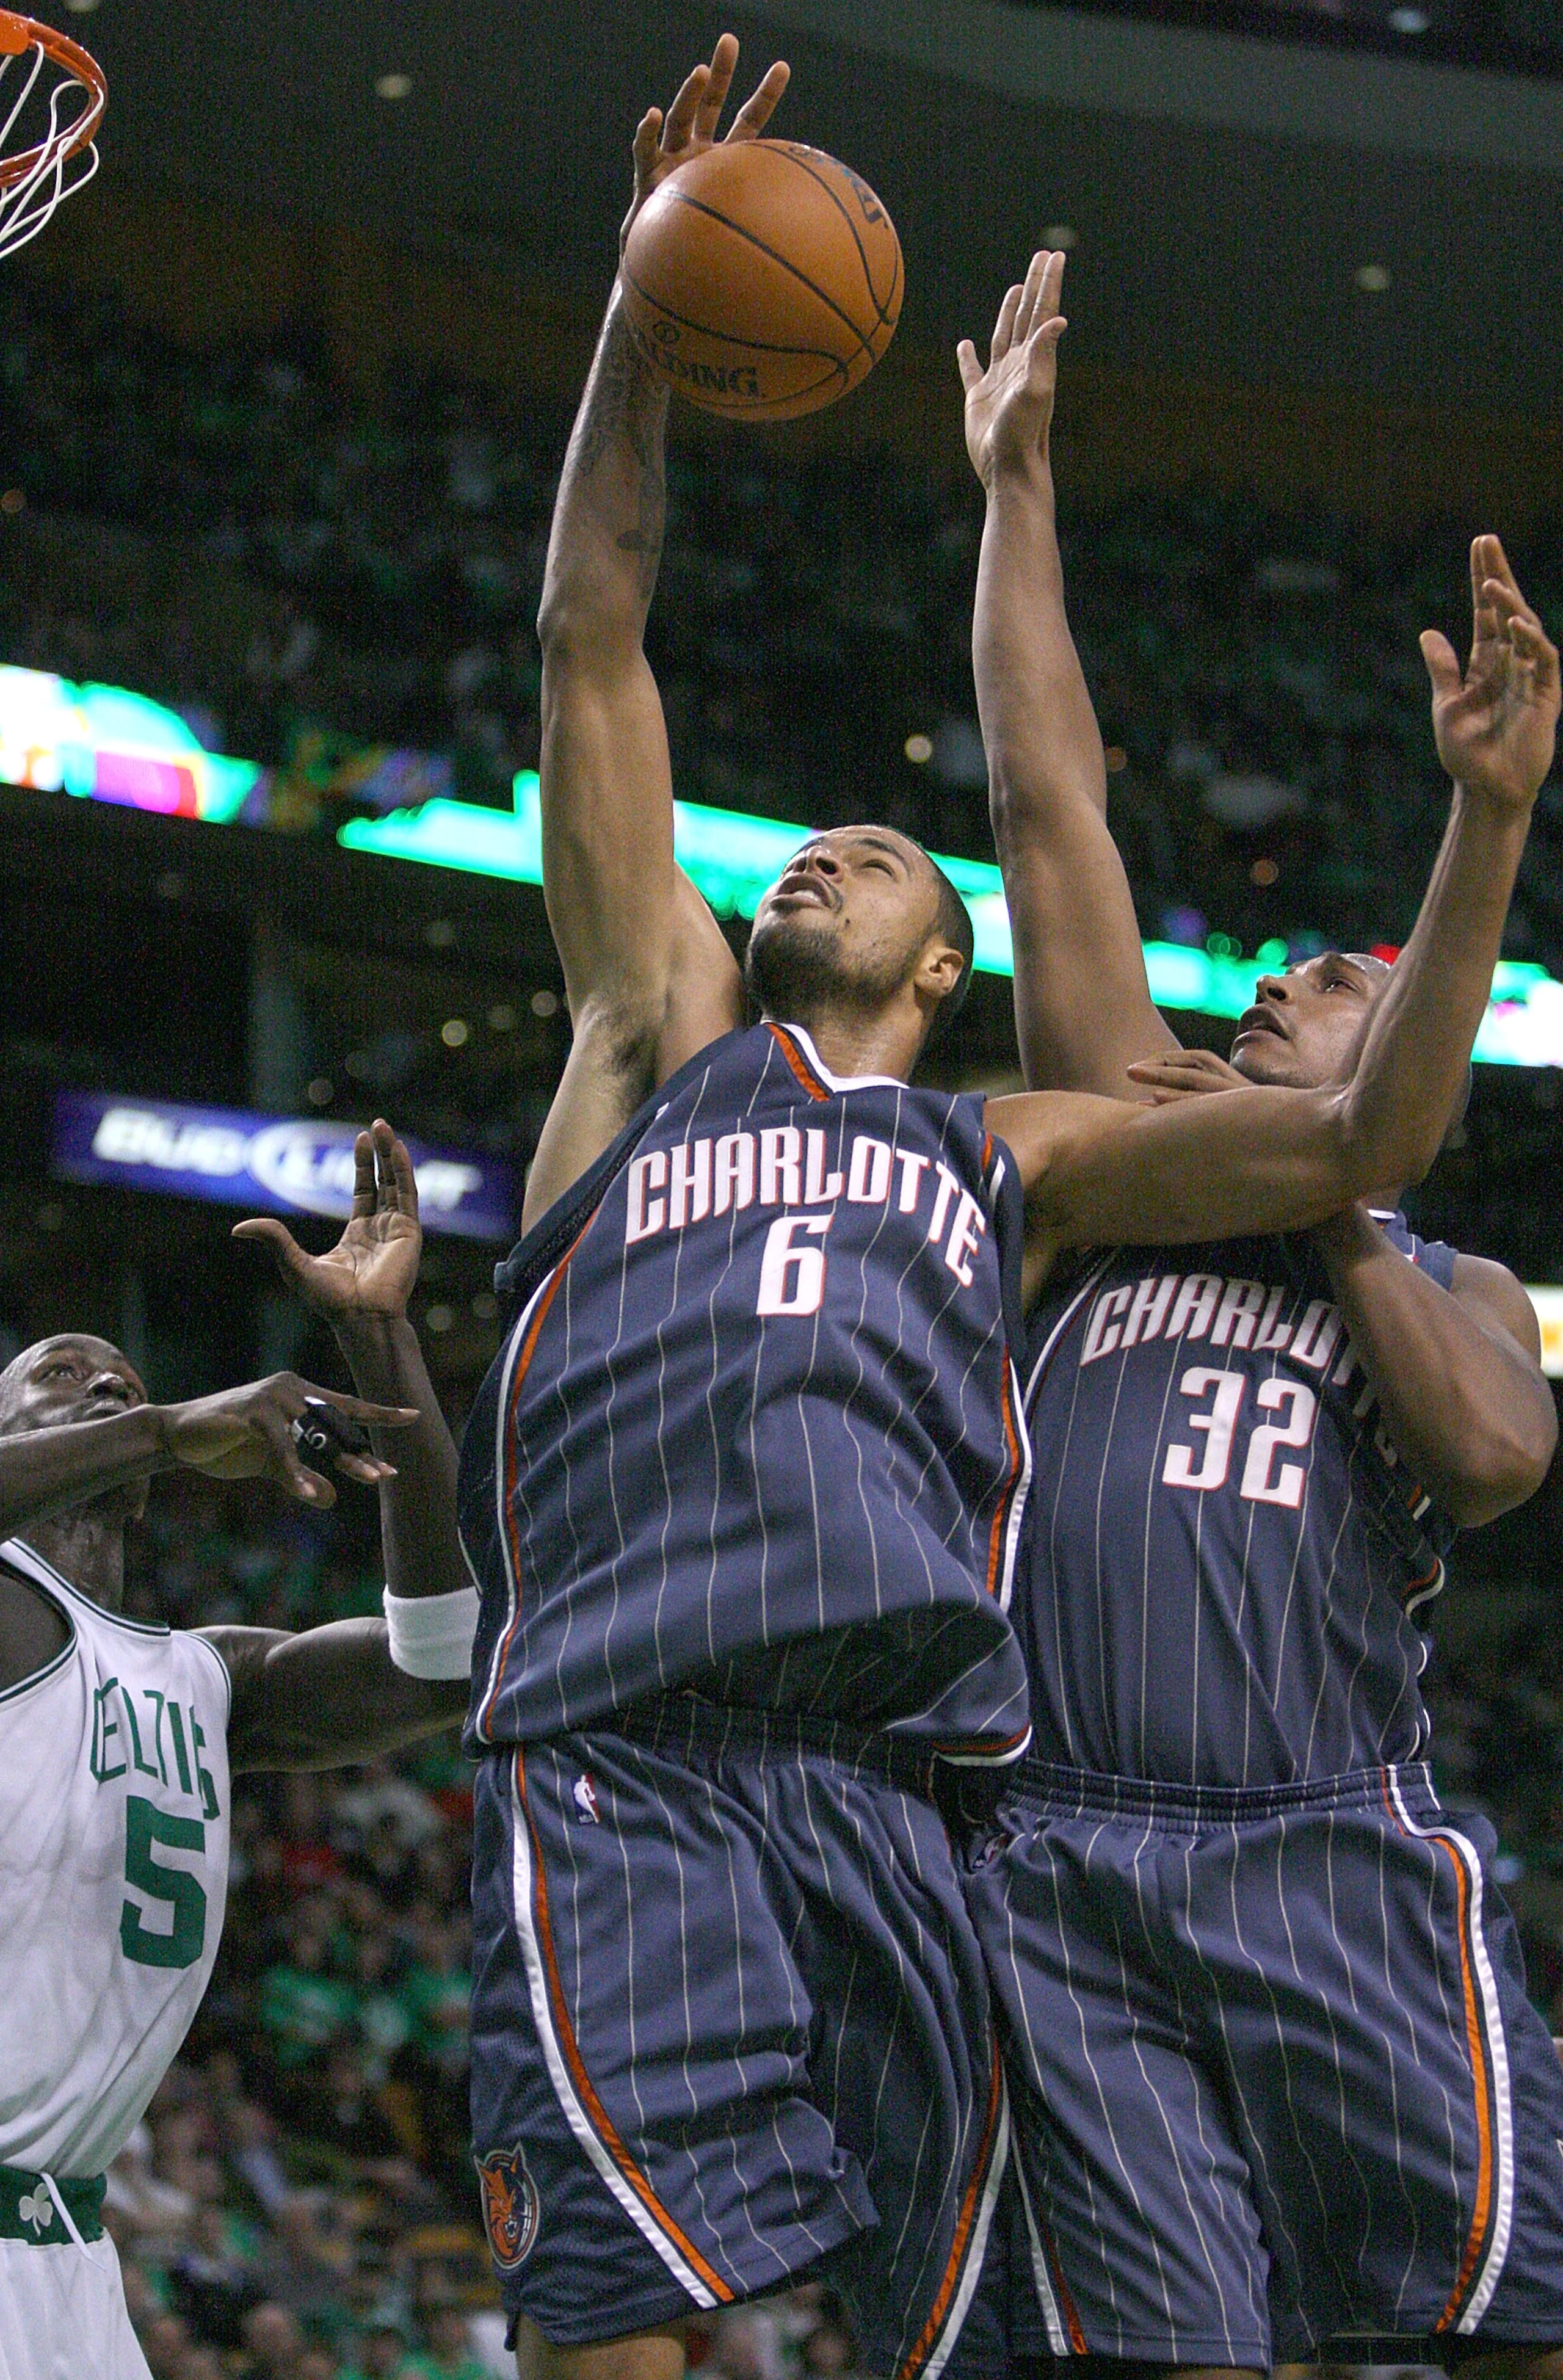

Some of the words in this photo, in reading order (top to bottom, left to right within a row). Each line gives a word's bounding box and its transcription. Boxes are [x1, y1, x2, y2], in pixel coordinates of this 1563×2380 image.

[626, 1126, 985, 1287] CHARLOTTE
[756, 1214, 834, 1316] 6
[1080, 1274, 1377, 1418] CHARLO
[1162, 1366, 1316, 1509] 32
[120, 1795, 206, 1968] 5
